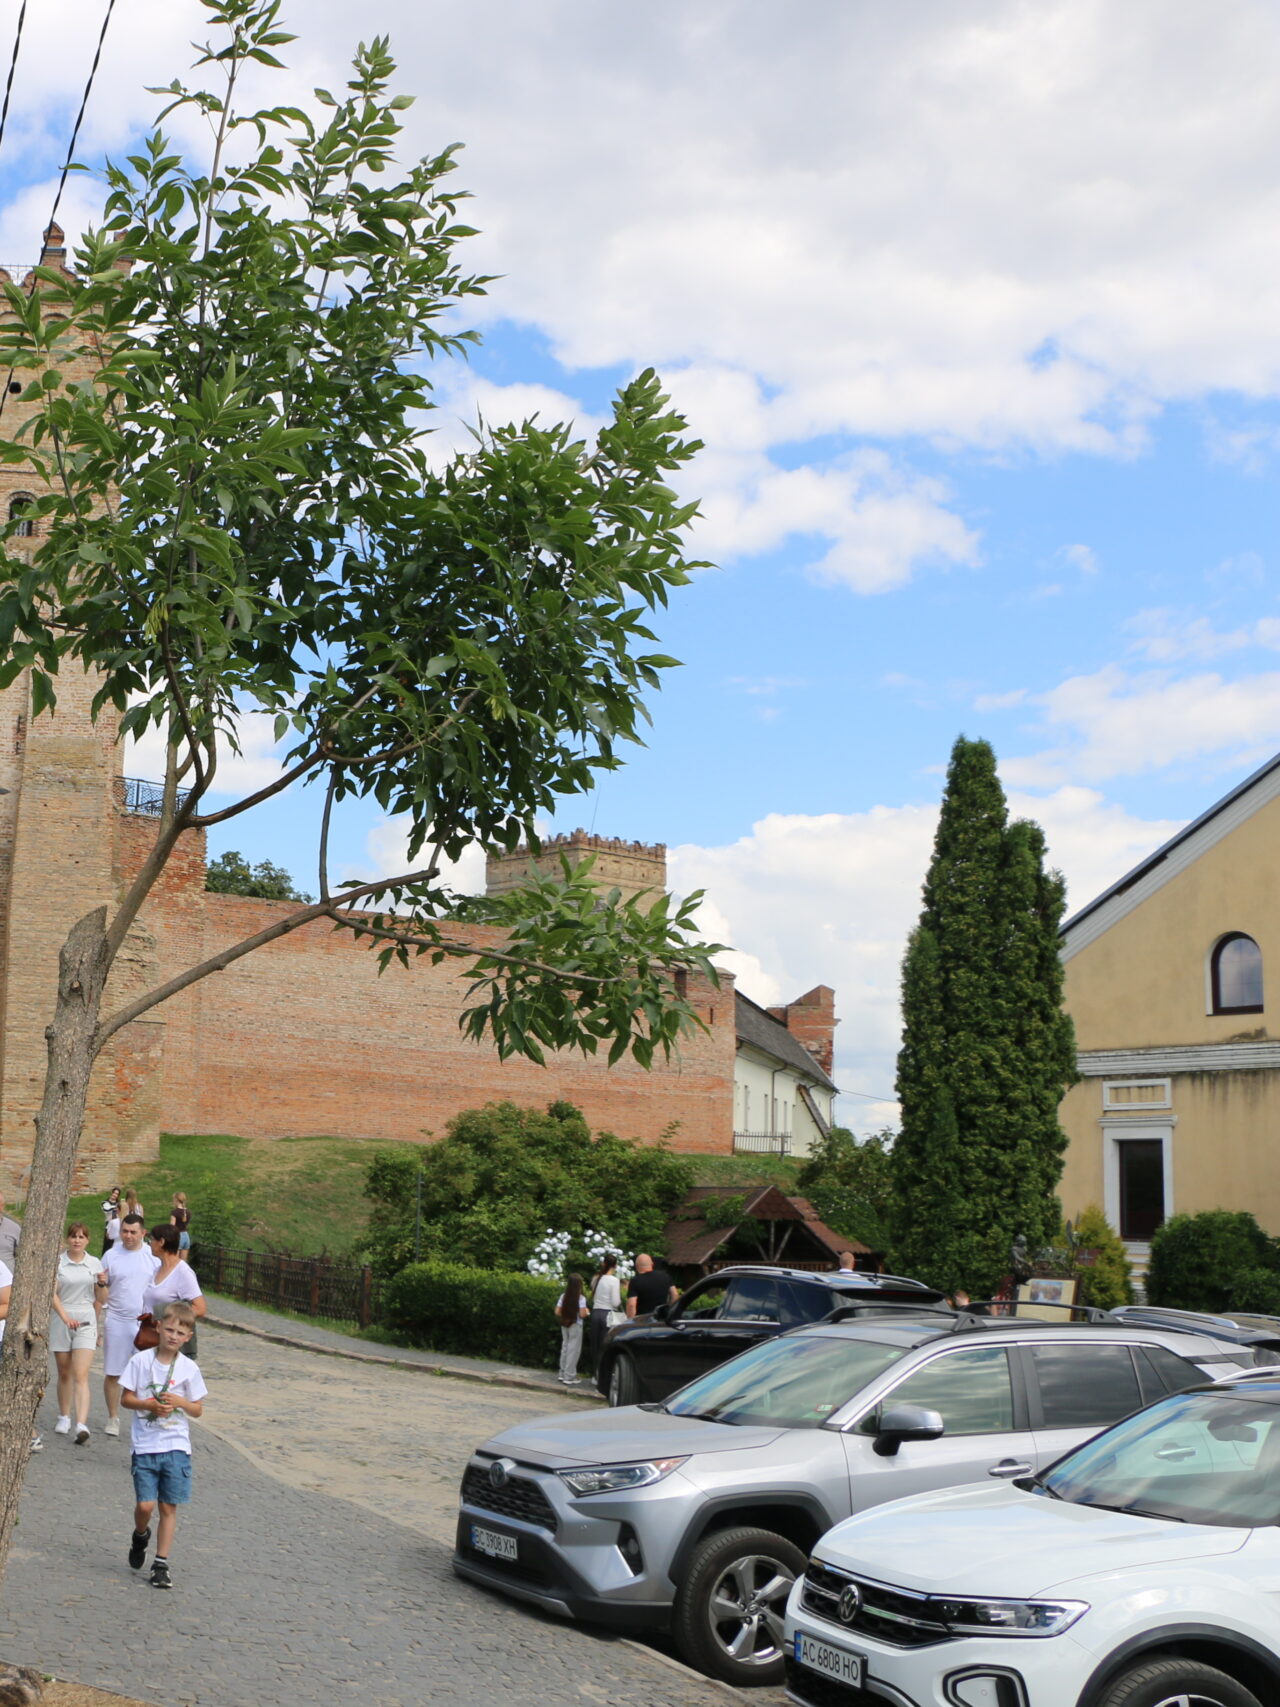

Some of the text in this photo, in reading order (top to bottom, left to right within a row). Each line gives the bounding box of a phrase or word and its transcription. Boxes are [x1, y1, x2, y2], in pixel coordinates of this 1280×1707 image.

[503, 1538, 516, 1556] XH
[802, 1640, 859, 1682] AC 6808 HO
